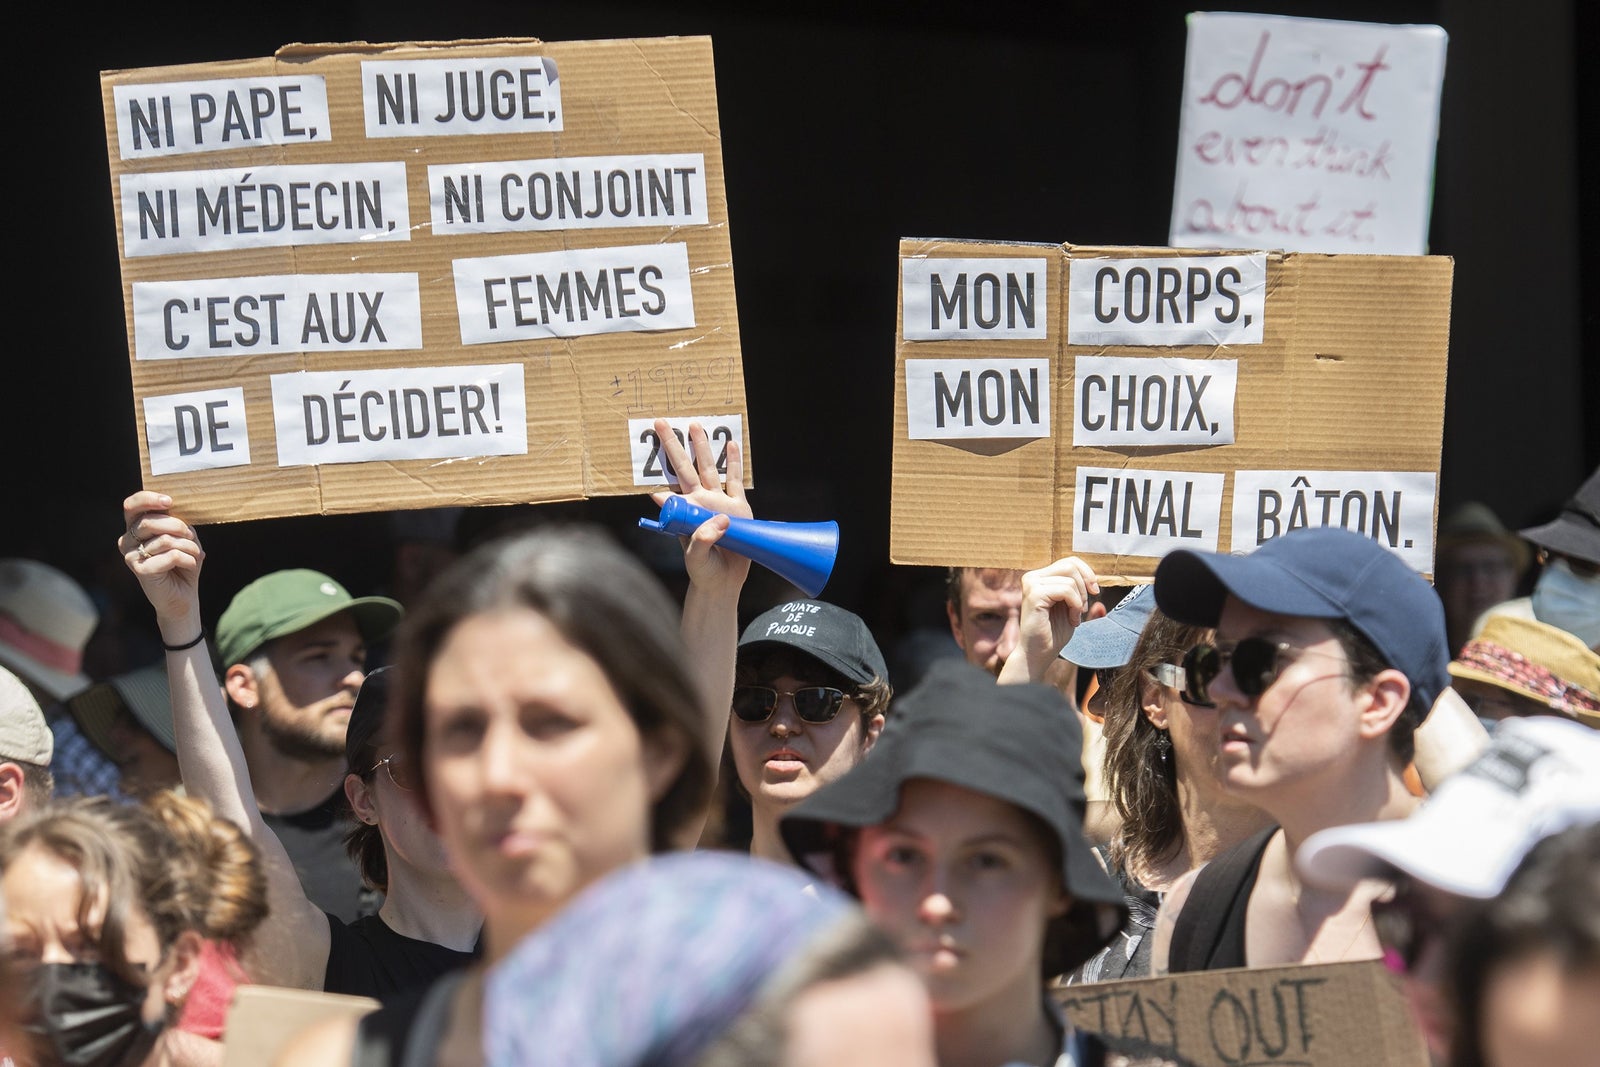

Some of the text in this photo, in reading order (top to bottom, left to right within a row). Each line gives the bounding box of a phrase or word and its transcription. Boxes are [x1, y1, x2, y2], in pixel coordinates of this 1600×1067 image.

[376, 68, 556, 125] NI JUGE,
[1199, 30, 1390, 120] don't
[129, 84, 317, 150] NI PAPE,
[137, 173, 395, 240] NI MÉDECIN,
[443, 167, 697, 224] NI CONJOINT
[163, 291, 388, 351] C'EST AUX
[484, 265, 666, 330] FEMMES
[930, 266, 1252, 330] MON CORPS,
[174, 380, 504, 456] DE DÉCIDER!
[934, 367, 1219, 437] MON CHOIX,
[1081, 475, 1414, 549] FINAL BÂTON.
[766, 622, 816, 637] PHOQUE
[782, 602, 821, 613] OUATE
[785, 612, 804, 622] DE
[1207, 976, 1330, 1064] OUT
